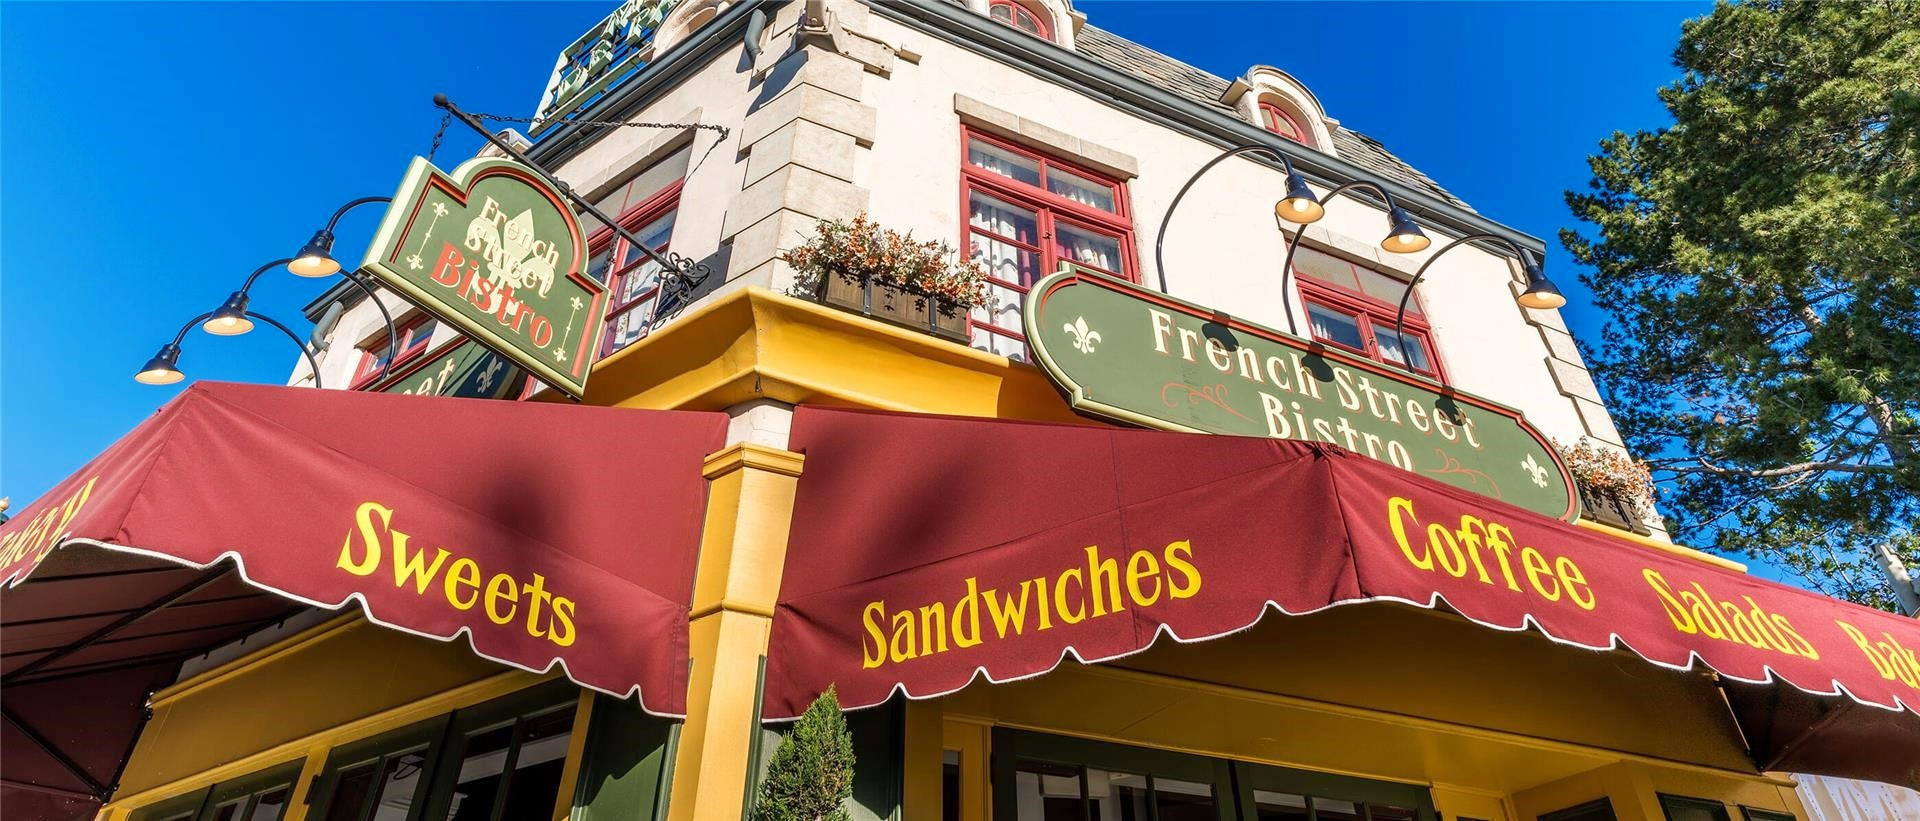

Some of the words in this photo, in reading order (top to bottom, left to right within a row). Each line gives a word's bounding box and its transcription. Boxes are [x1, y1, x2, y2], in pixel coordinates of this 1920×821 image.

[464, 225, 552, 299] Street
[479, 195, 560, 270] French
[430, 240, 553, 349] Bistro
[1147, 308, 1322, 400] French
[1332, 366, 1481, 449] Street
[1257, 391, 1413, 473] Bistro
[336, 501, 577, 647] Sweets
[862, 539, 1202, 670] Sandwiches
[1387, 496, 1596, 611] Coffee
[1642, 568, 1819, 661] Salads
